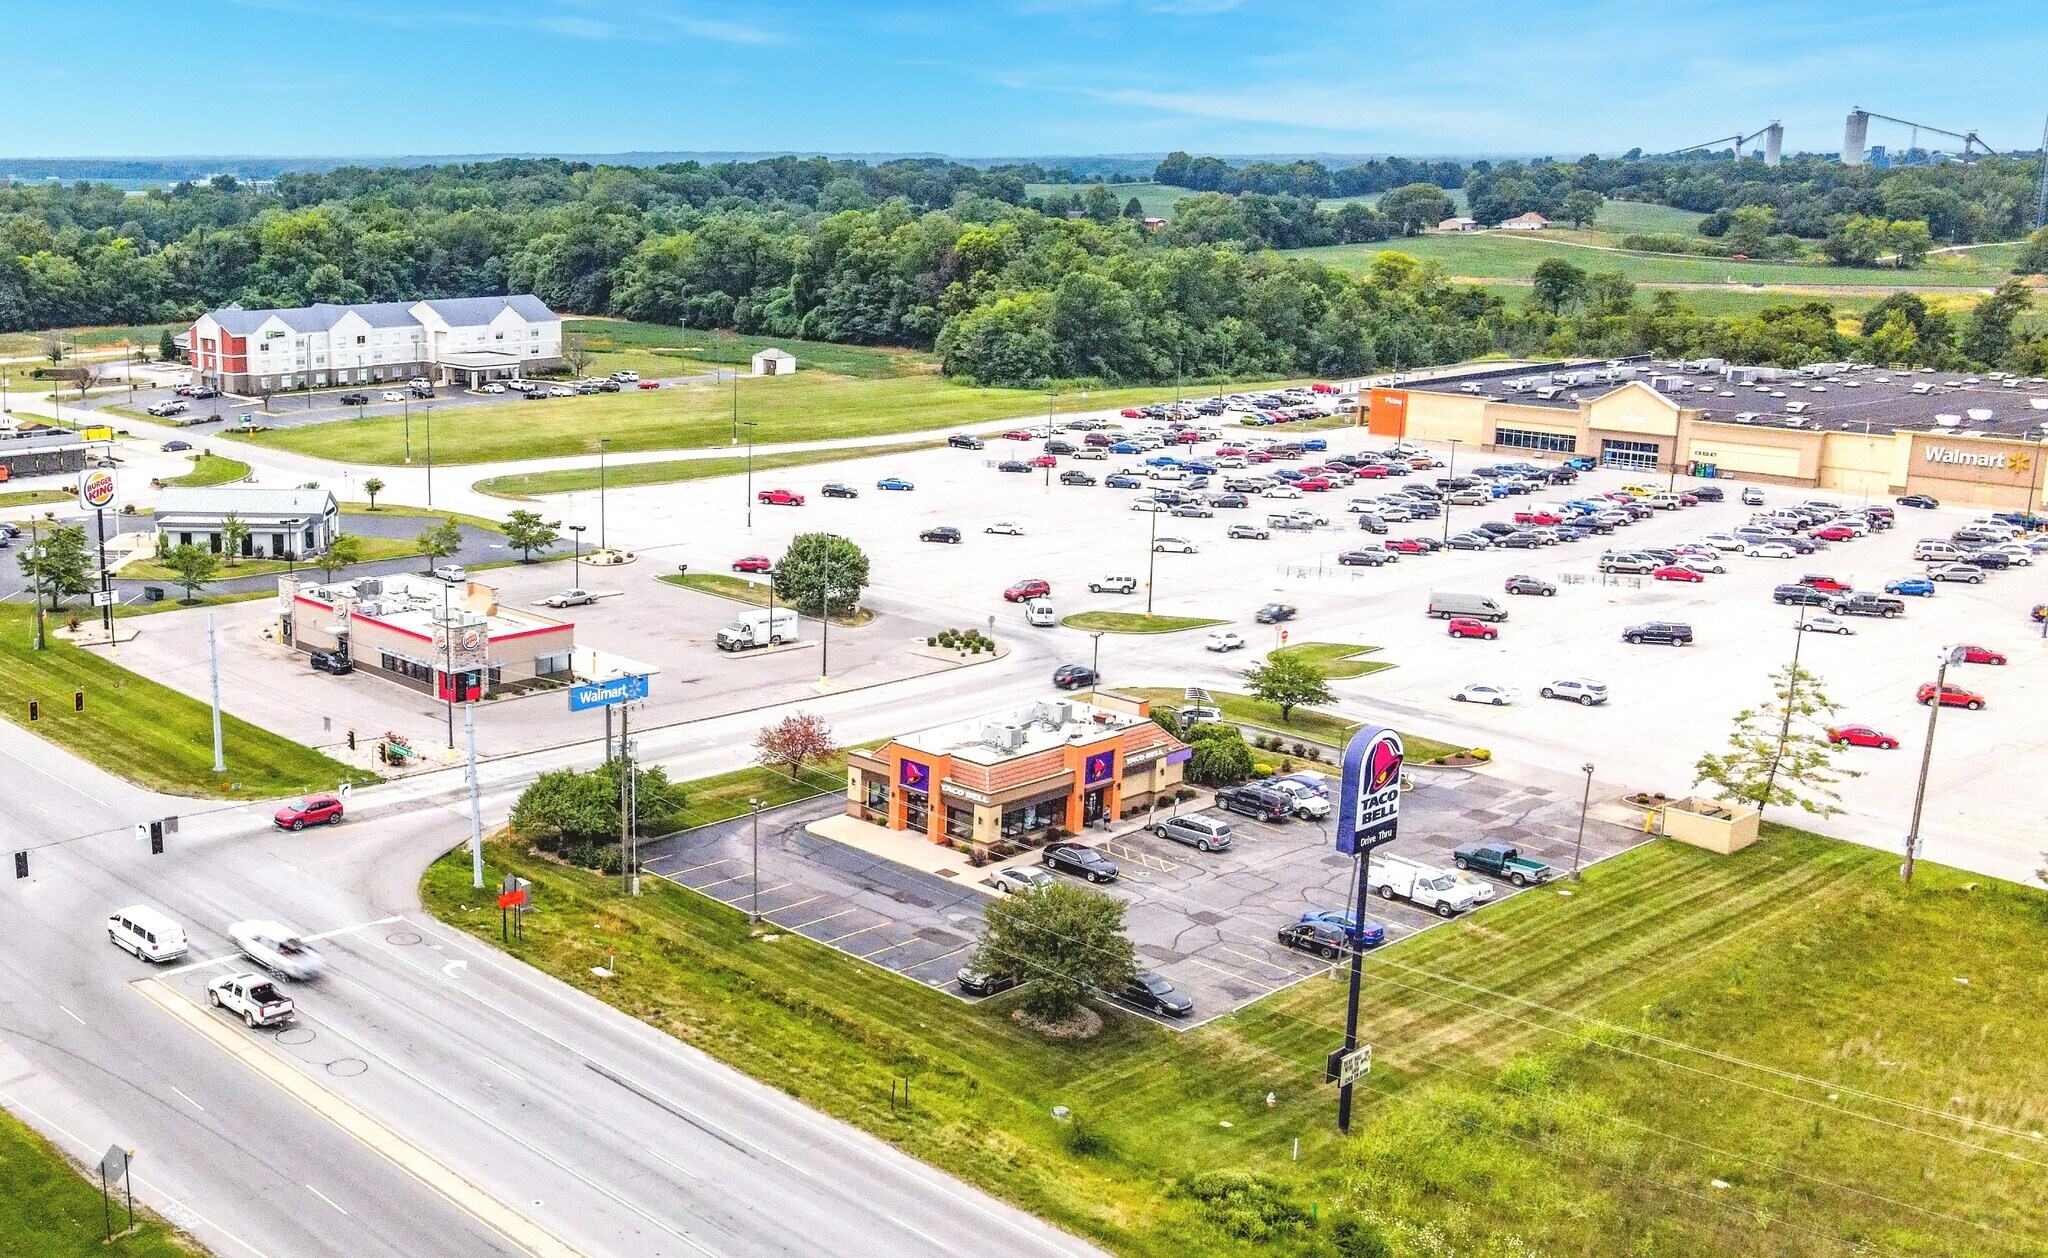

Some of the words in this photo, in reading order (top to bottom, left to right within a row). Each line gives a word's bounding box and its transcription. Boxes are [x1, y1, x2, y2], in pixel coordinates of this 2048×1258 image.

[1925, 446, 2005, 468] Walmart
[87, 476, 112, 491] BURGER
[88, 483, 113, 500] KING
[580, 684, 627, 704] Walmart
[1126, 754, 1145, 764] TACO
[1146, 750, 1163, 759] BELL
[941, 784, 965, 796] TACO
[965, 791, 989, 803] BELL
[1361, 790, 1398, 810] TACO
[1362, 804, 1397, 825] BELL
[1361, 834, 1376, 847] Drive
[1379, 829, 1392, 841] Thru
